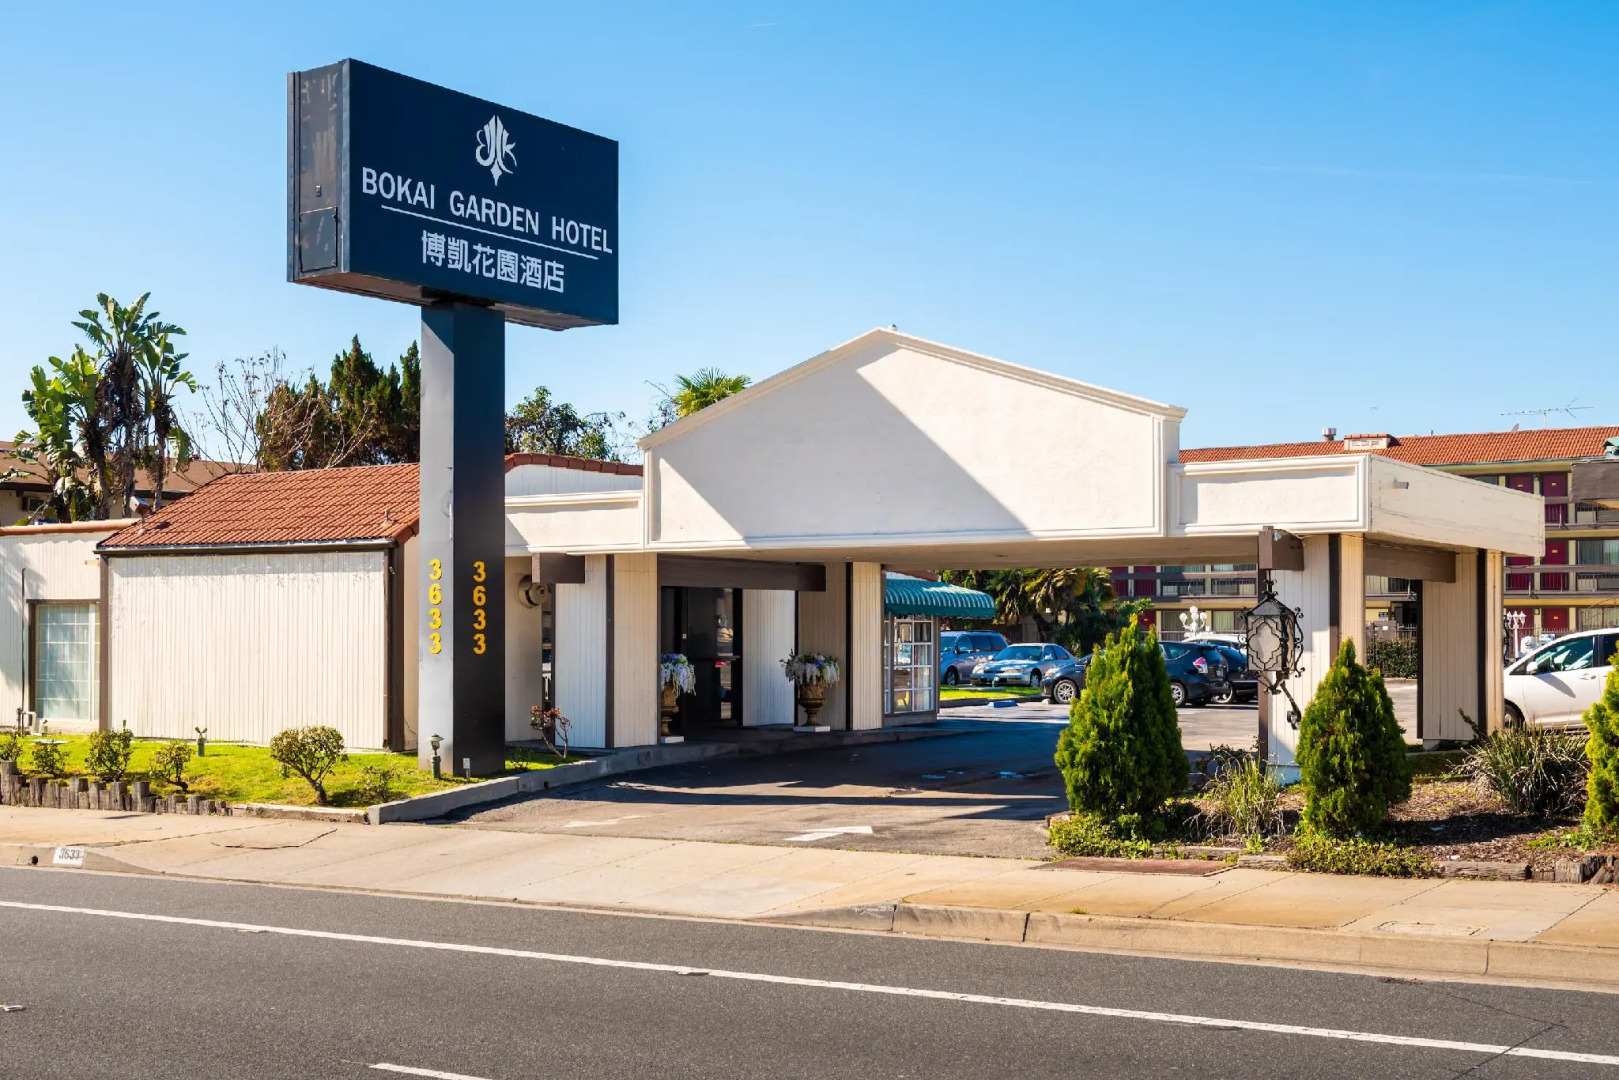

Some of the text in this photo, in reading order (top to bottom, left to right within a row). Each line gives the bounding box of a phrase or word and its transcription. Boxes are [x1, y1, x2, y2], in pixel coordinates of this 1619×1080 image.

[362, 166, 612, 254] BOKAI GARDEN HOTEL
[421, 229, 565, 293] 博凱花園酒店
[428, 558, 442, 655] 3633
[472, 560, 487, 655] 3633
[58, 848, 81, 860] 3633
